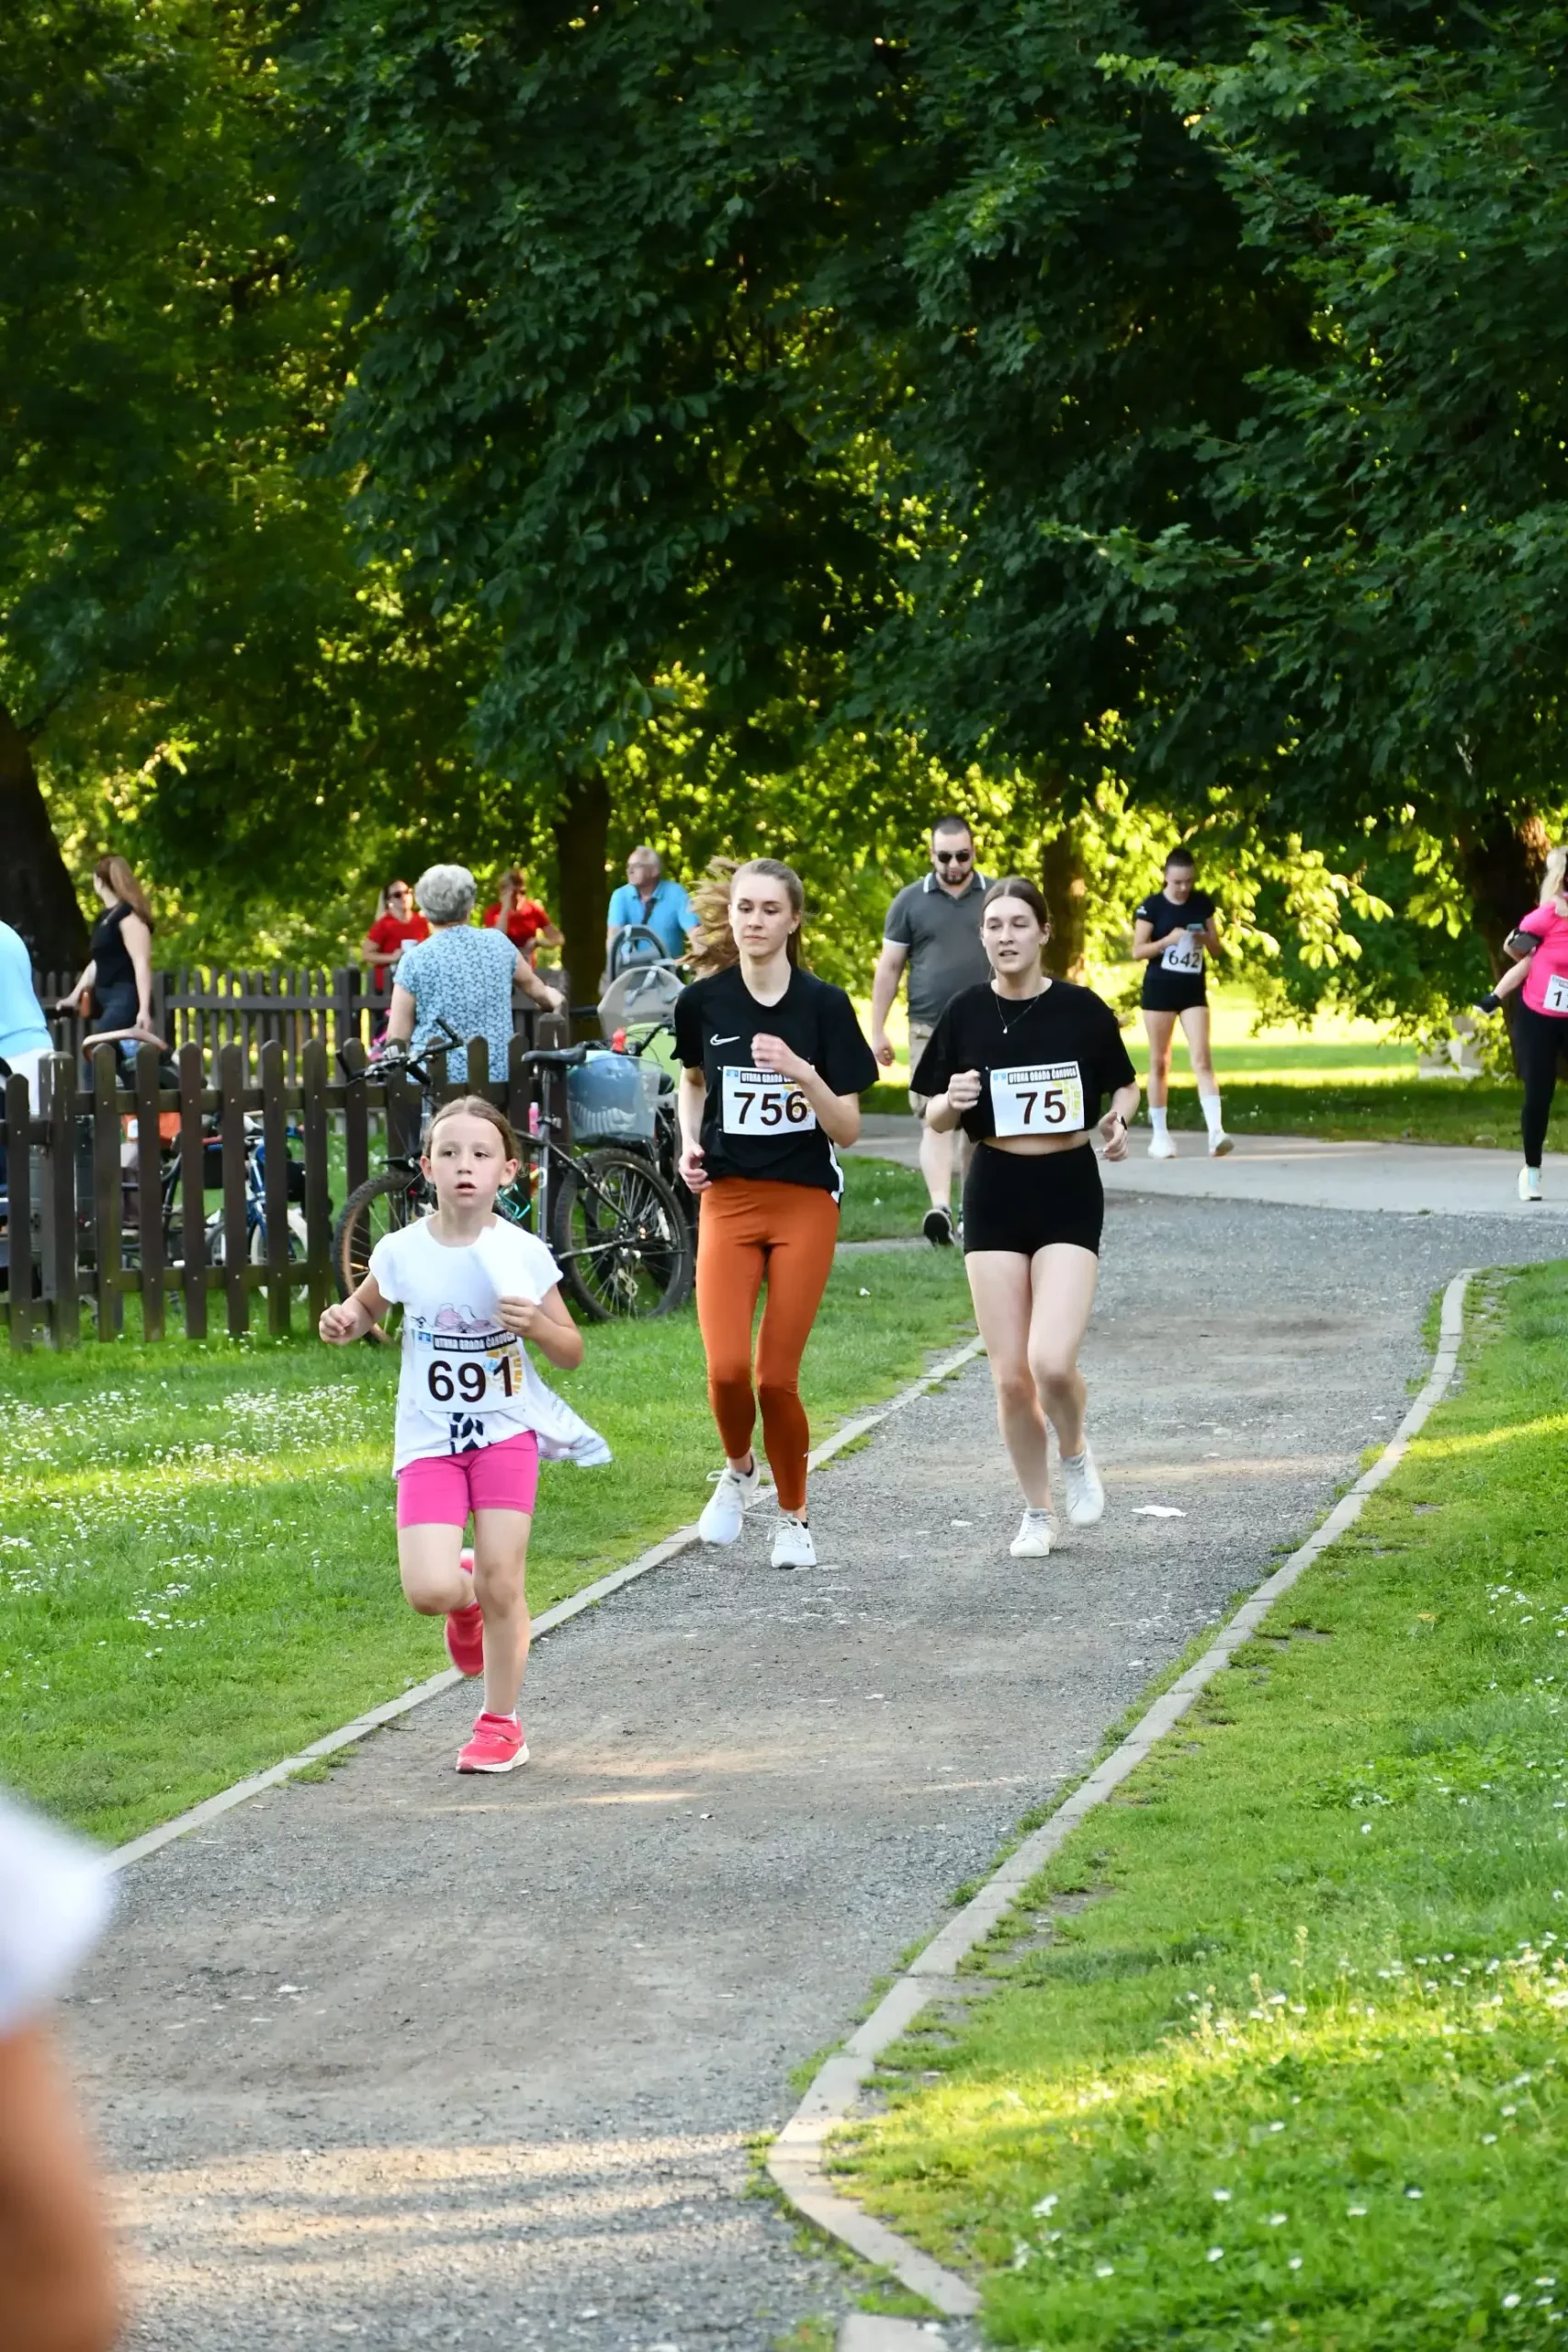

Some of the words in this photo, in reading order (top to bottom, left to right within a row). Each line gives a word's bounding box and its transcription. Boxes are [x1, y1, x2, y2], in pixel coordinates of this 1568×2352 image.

[1168, 950, 1200, 968] 642
[733, 1091, 808, 1126] 756
[1015, 1090, 1066, 1125] 75
[428, 1355, 513, 1403] 691
